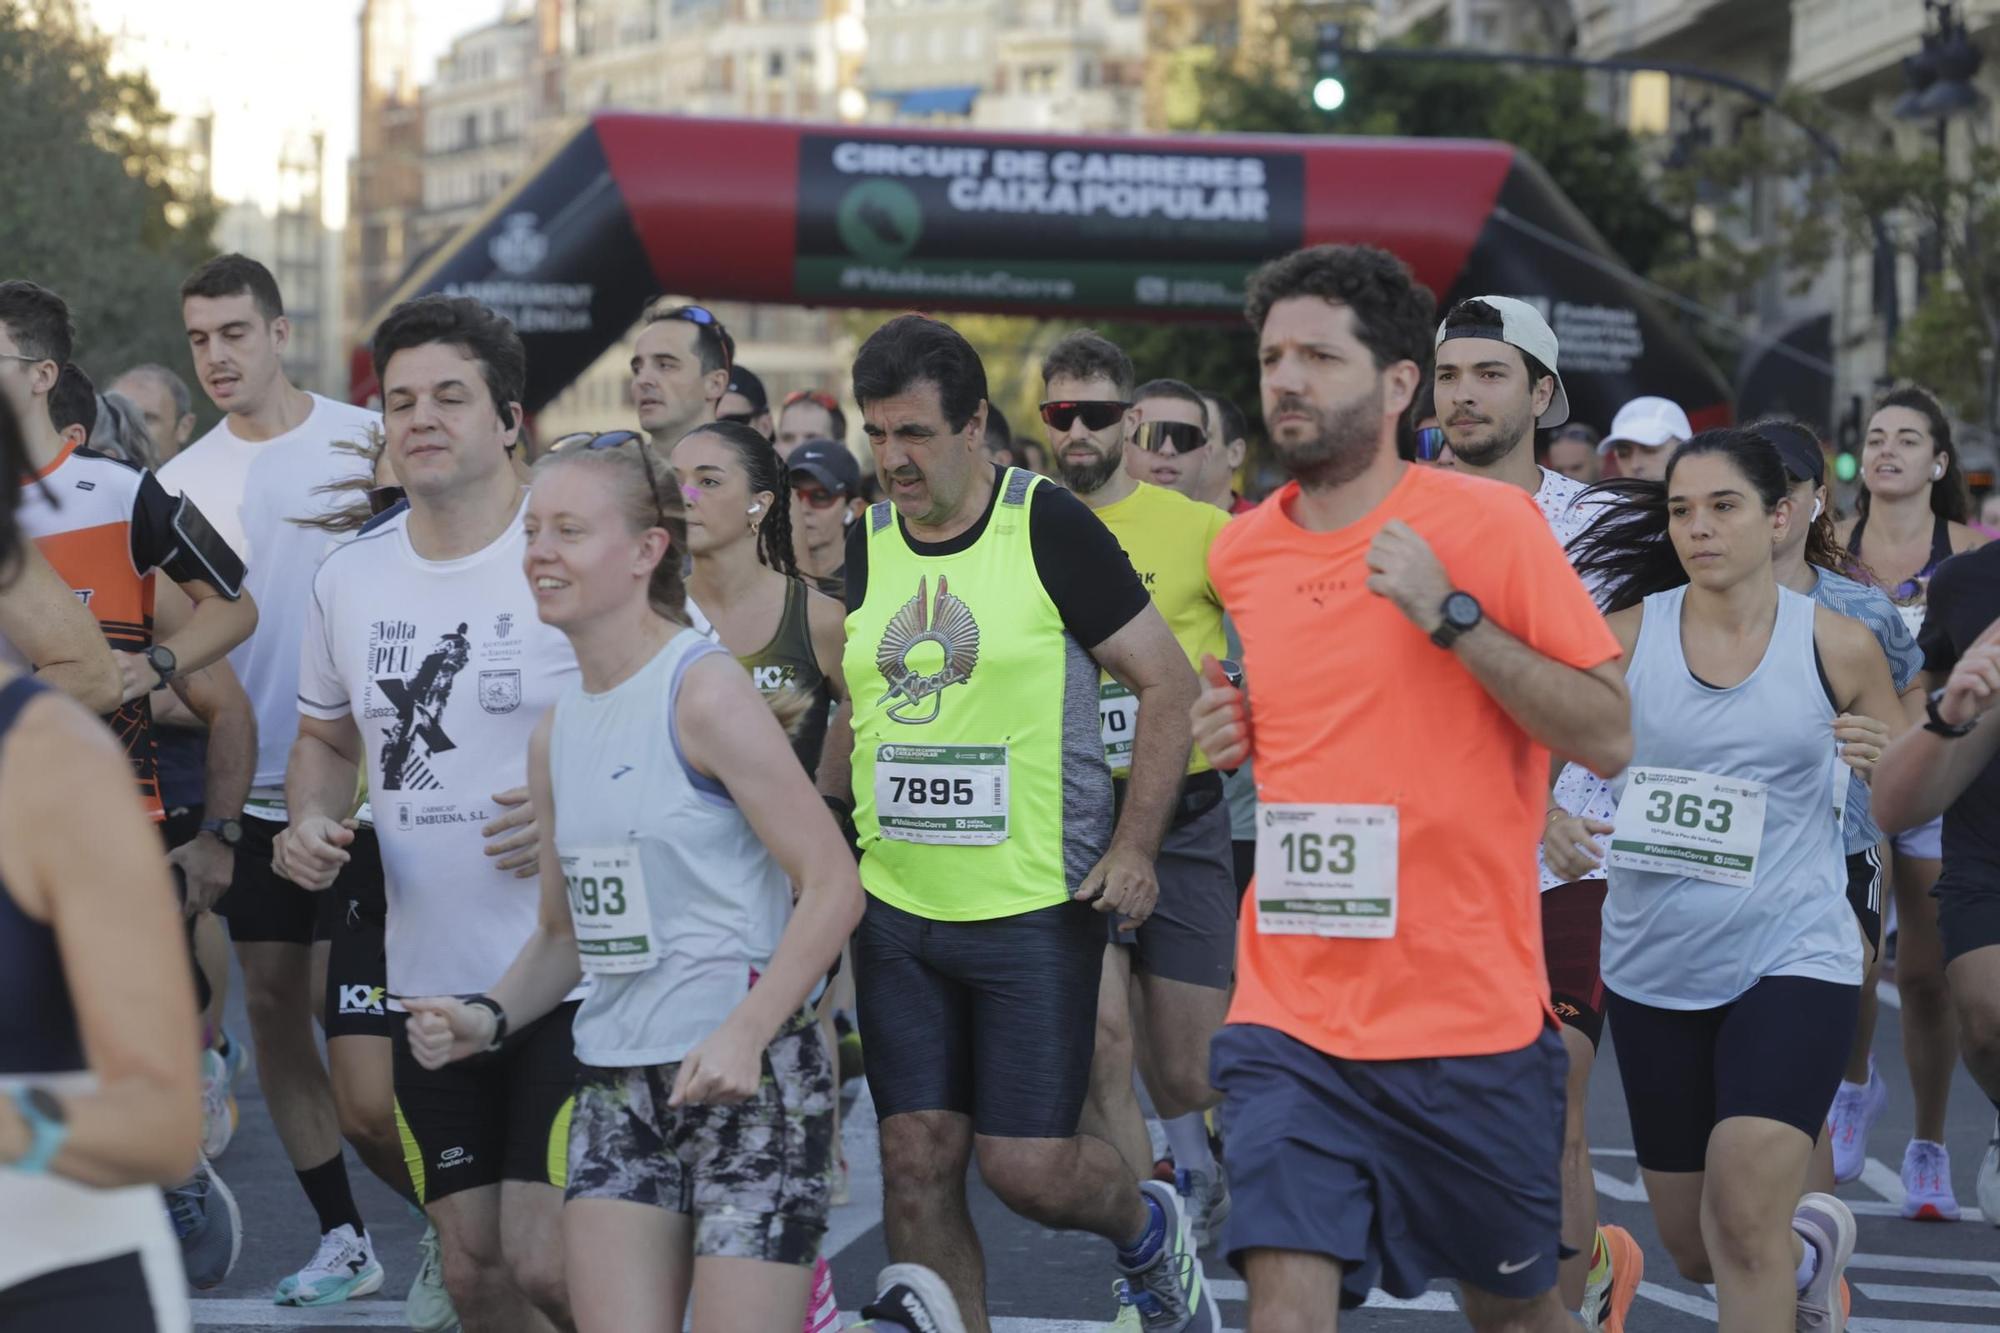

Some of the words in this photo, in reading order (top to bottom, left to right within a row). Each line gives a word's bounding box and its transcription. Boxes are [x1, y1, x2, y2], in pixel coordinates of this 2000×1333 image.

[834, 142, 987, 177] CIRCUIT
[992, 149, 1047, 180] DE
[1051, 152, 1266, 188] CARRERES
[949, 178, 1077, 214] CAIXA
[1079, 183, 1269, 222] POPULAR
[379, 620, 416, 641] Volta
[375, 645, 414, 674] PEU
[889, 776, 974, 805] 7895
[1646, 790, 1733, 833] 363
[1280, 832, 1356, 874] 163
